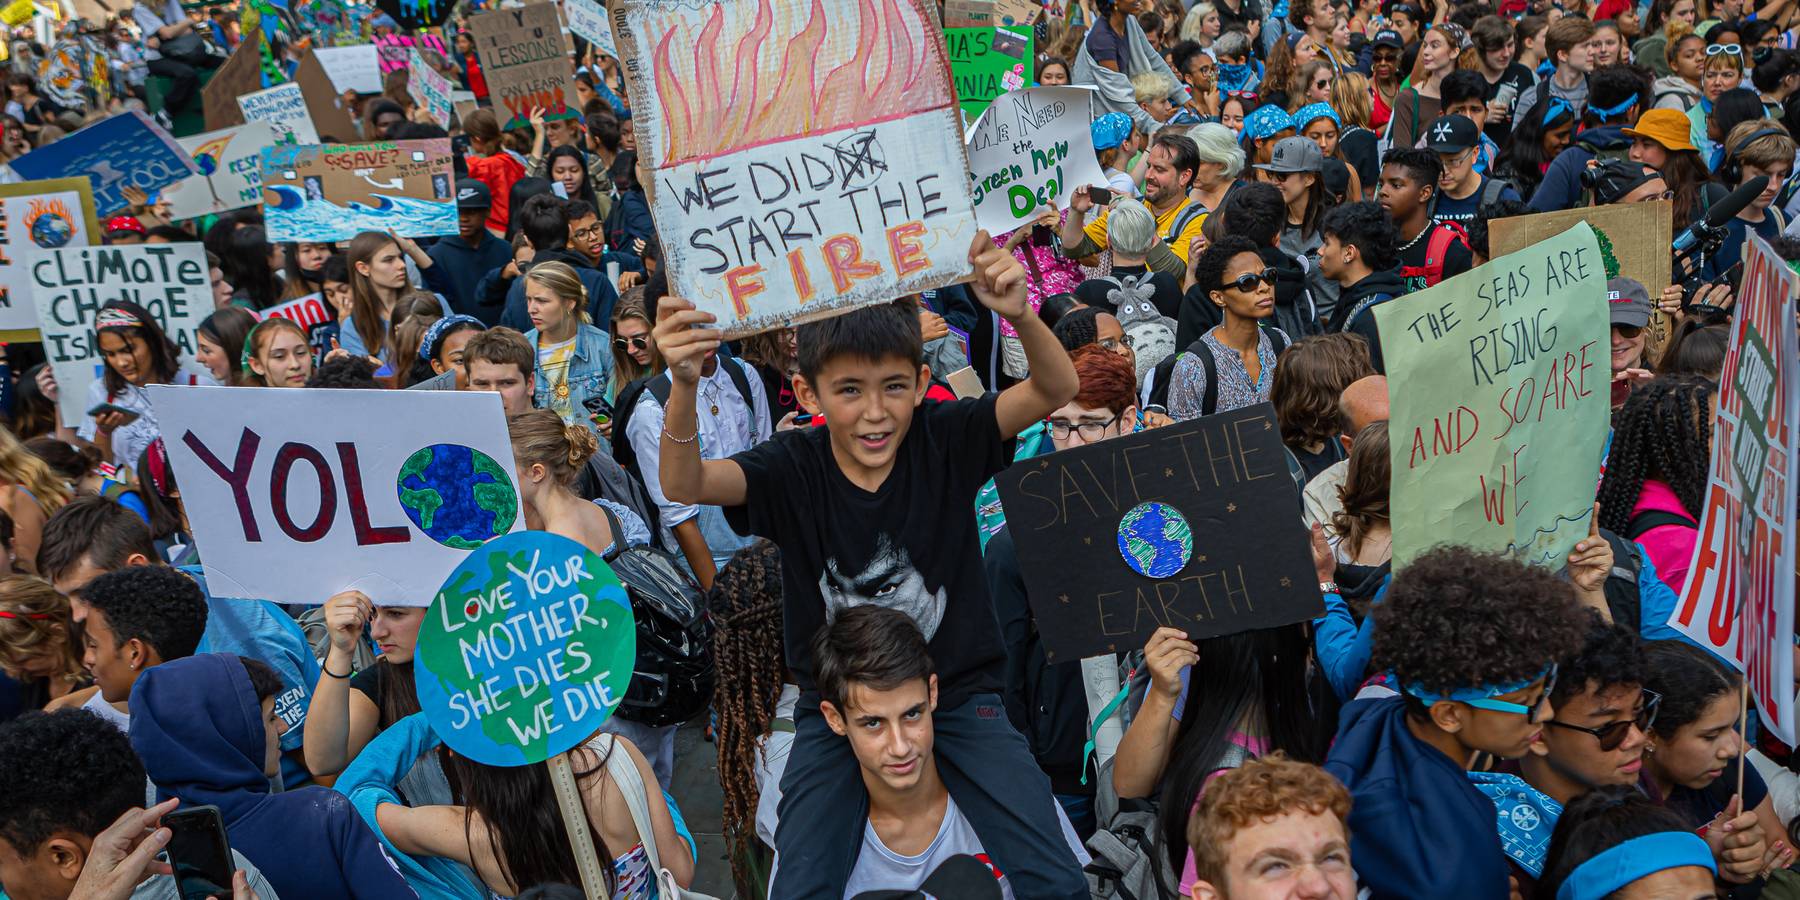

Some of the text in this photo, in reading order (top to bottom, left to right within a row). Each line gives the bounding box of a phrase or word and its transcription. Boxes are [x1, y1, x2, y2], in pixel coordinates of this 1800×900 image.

[487, 37, 561, 70] LESSONS
[945, 31, 989, 58] IA'S
[526, 74, 566, 95] LEARN
[953, 73, 1000, 98] ANIA
[1013, 139, 1034, 155] the
[665, 166, 739, 217] WE
[690, 174, 949, 275] START THE
[1007, 165, 1064, 219] Deal
[723, 220, 932, 320] FIRE
[1407, 246, 1590, 343] THE SEAS ARE
[1469, 307, 1558, 386] RISING
[1739, 339, 1774, 422] STRIKE
[1410, 340, 1599, 469] AND SO ARE
[1018, 415, 1276, 530] SAVE THE
[1479, 444, 1529, 526] WE
[1736, 419, 1764, 494] WITH
[439, 548, 594, 633] LOVE YOUR
[1097, 563, 1254, 637] EARTH
[458, 593, 608, 680] MOTHER,
[448, 641, 593, 730] SHE DIES
[506, 670, 622, 747] WE DIE
